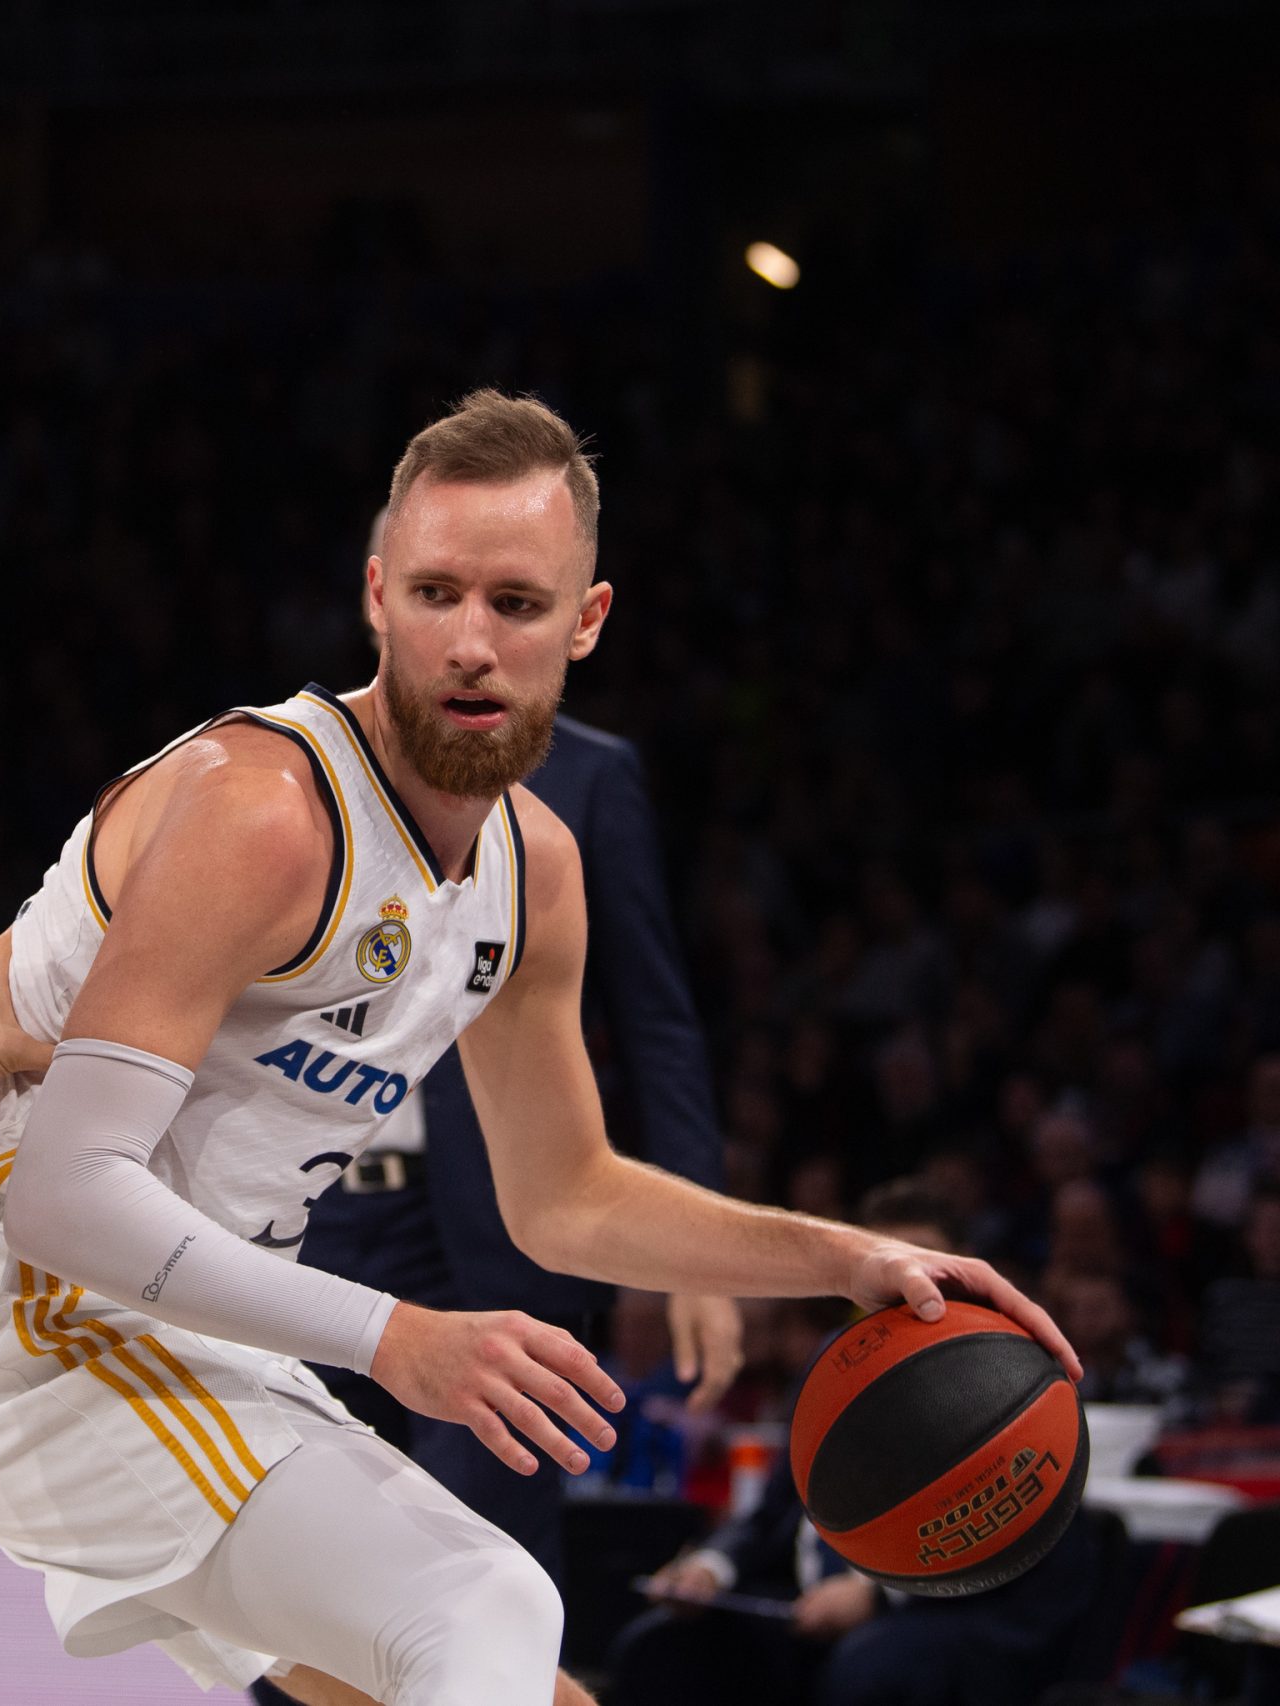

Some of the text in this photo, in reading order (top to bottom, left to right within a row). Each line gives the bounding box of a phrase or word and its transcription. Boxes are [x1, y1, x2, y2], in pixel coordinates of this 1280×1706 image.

[477, 955, 492, 974] liga
[253, 1039, 410, 1115] AUTO
[916, 1451, 1061, 1566] LEGACY
[917, 1475, 1010, 1539] 1000
